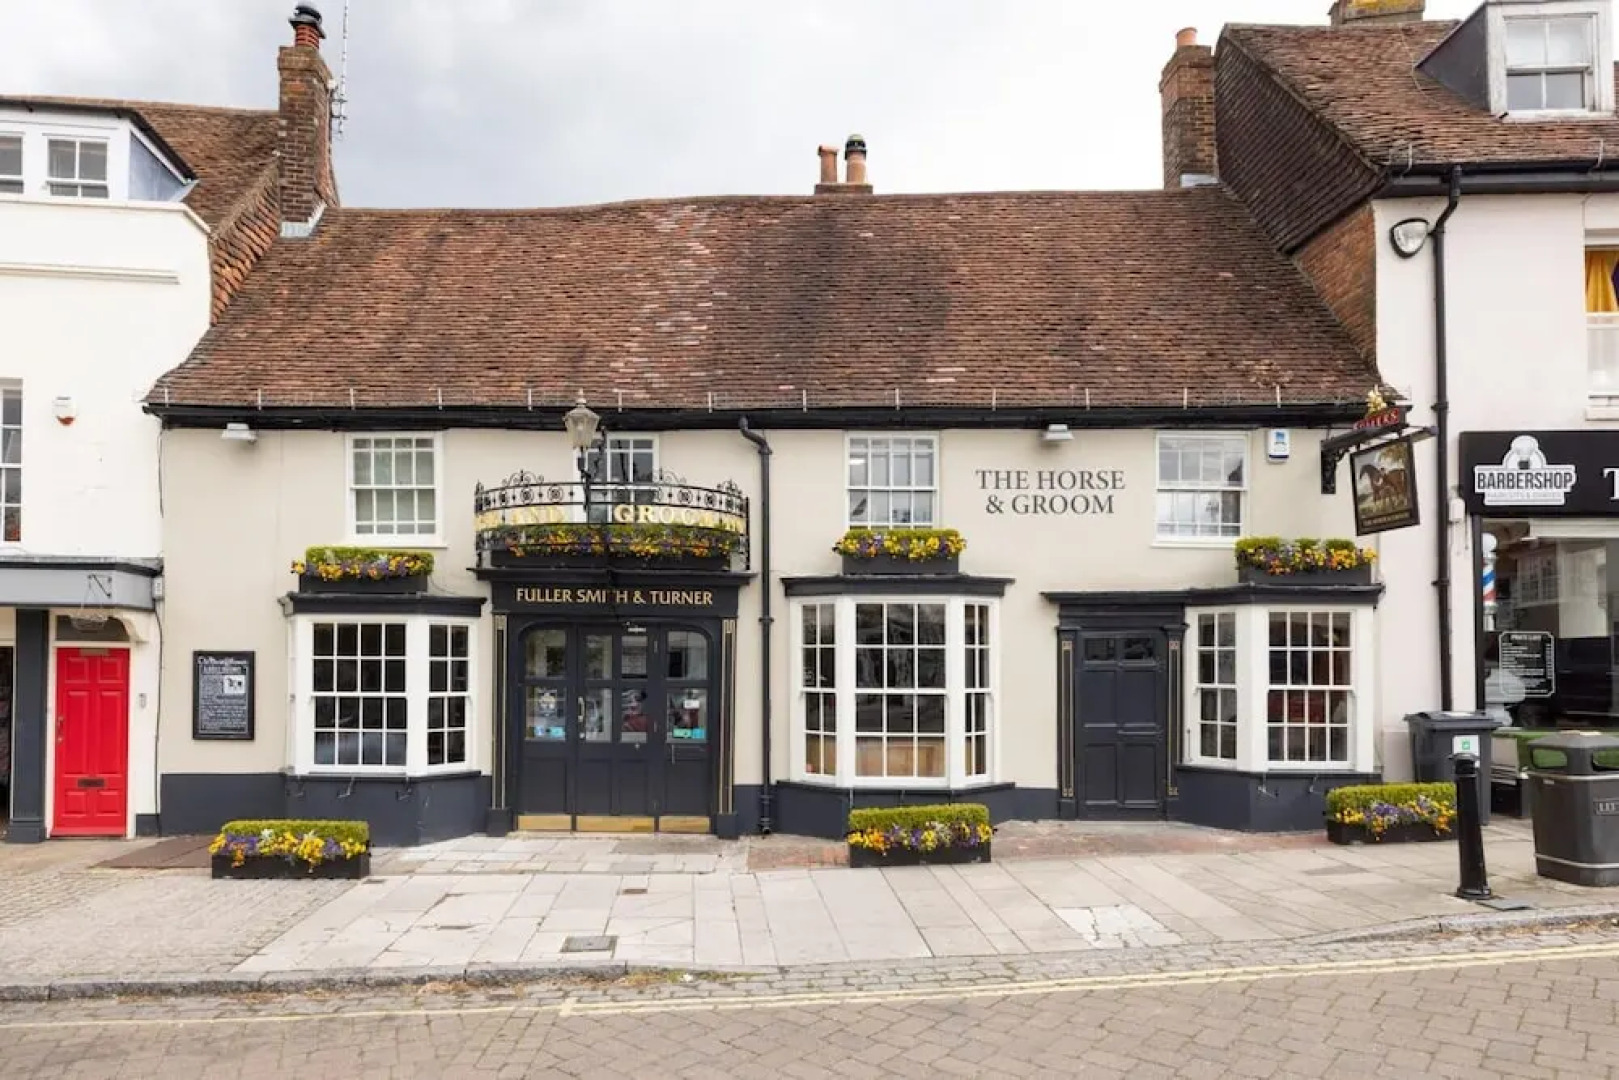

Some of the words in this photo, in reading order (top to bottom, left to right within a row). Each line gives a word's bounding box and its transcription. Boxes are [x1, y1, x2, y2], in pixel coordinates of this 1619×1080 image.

[975, 469, 1030, 490] THE
[1036, 469, 1126, 490] HORSE
[1477, 472, 1573, 490] BARBERSHOP
[985, 494, 1004, 514] &
[1011, 494, 1115, 515] GROOM
[515, 587, 573, 603] FULLER
[576, 588, 629, 604] SMIH
[632, 590, 647, 605] &
[649, 590, 713, 606] TURNER
